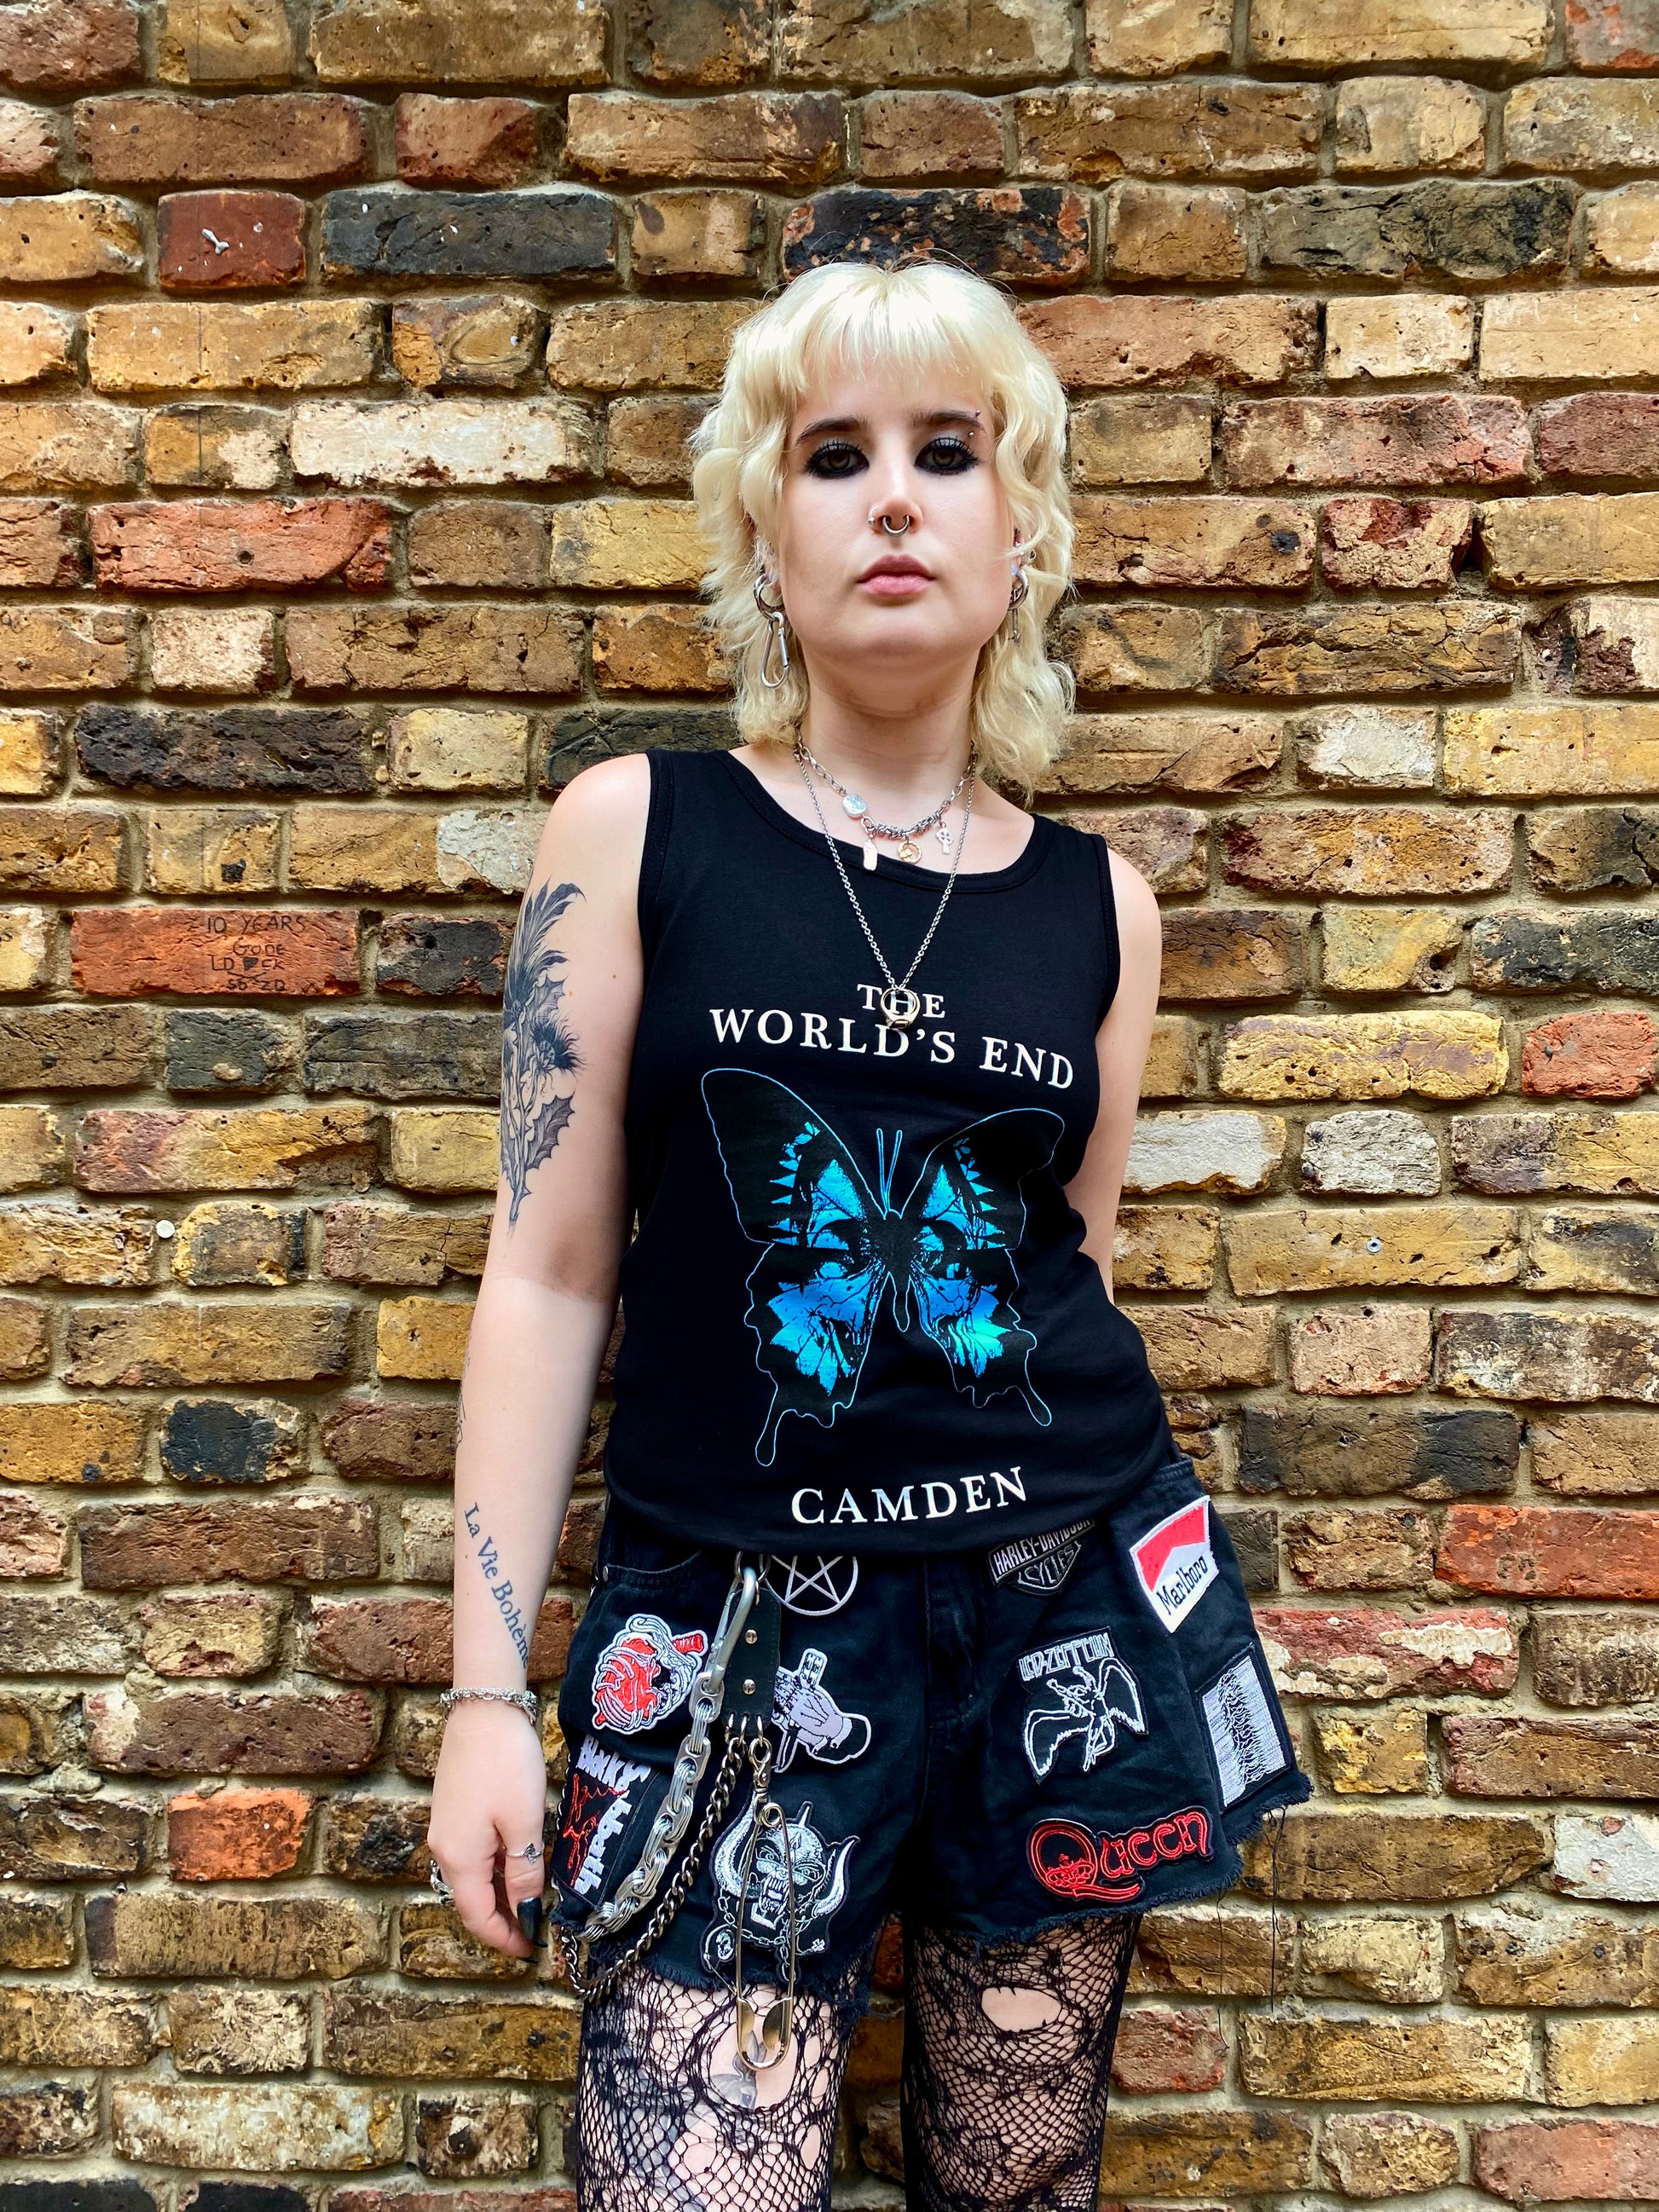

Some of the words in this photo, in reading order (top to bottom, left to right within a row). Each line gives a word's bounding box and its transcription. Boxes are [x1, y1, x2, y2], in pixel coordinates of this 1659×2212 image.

[207, 916, 227, 933] 10
[240, 915, 306, 934] YEARS
[857, 984, 945, 1019] THE
[708, 1008, 956, 1064] WORLD'S
[980, 1037, 1073, 1089] END
[791, 1466, 1026, 1524] CAMDEN
[464, 1502, 481, 1539] La
[477, 1536, 498, 1580] Vie
[1156, 1555, 1208, 1616] Marlboro
